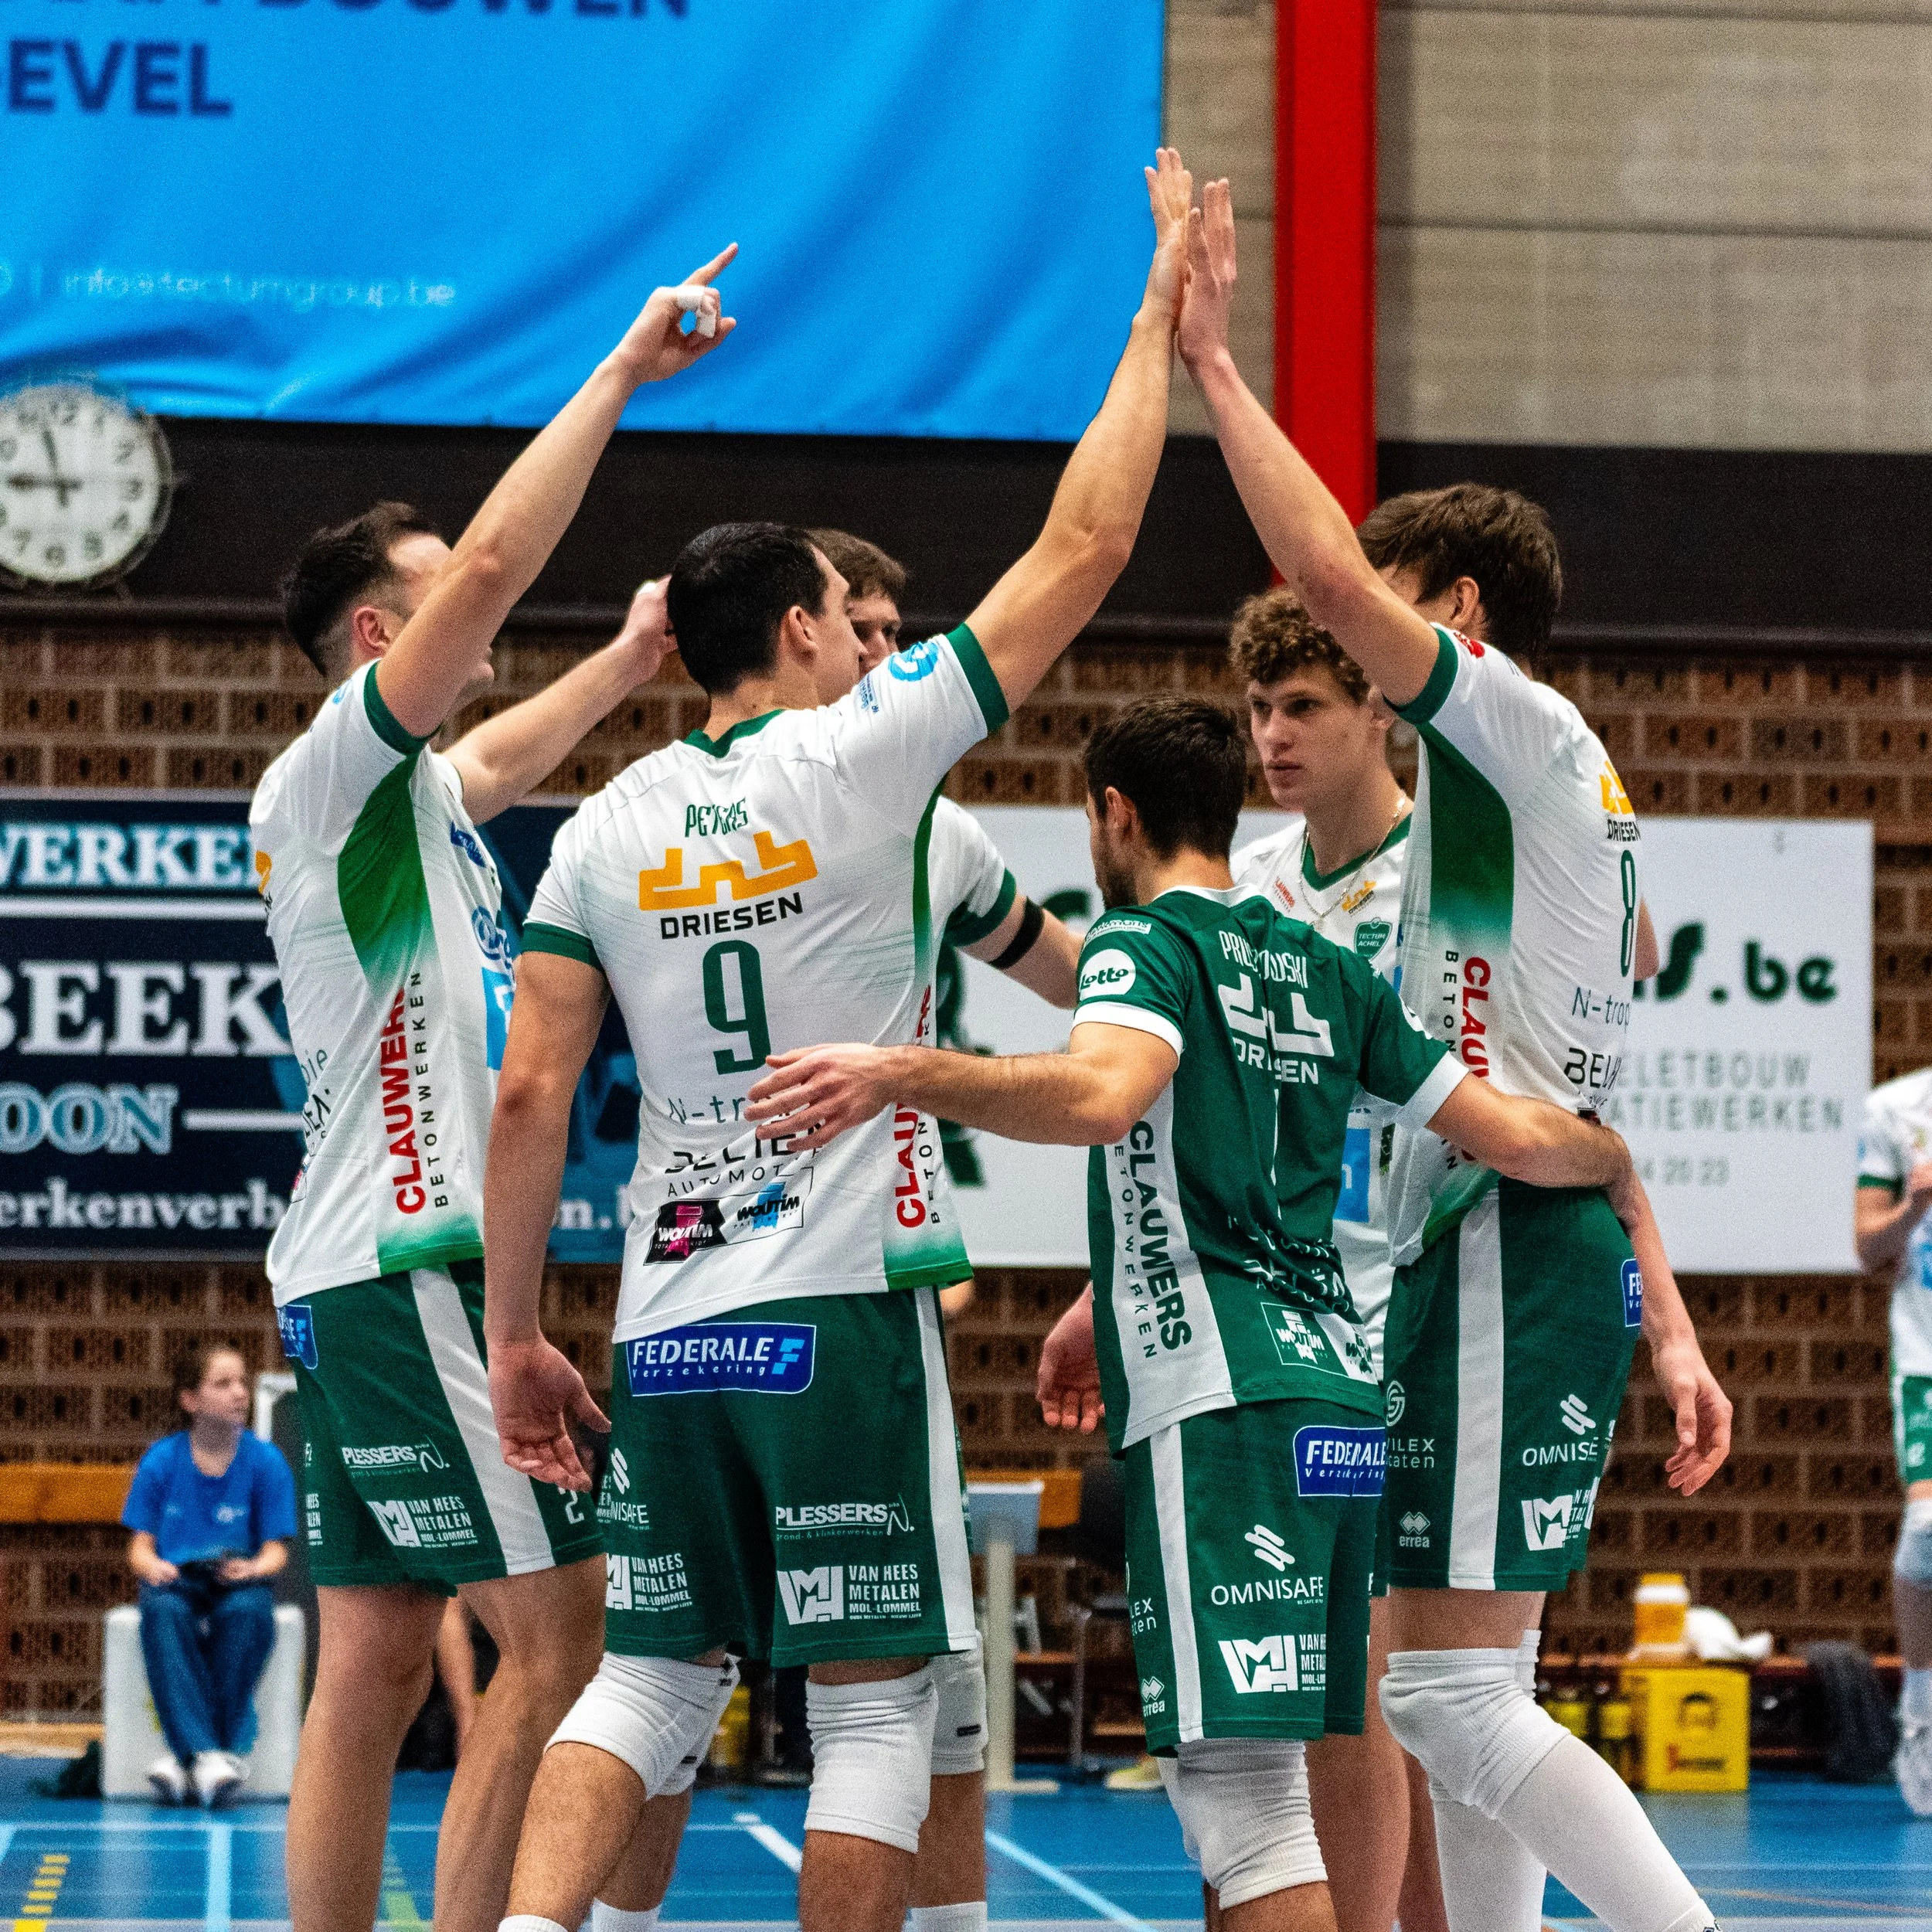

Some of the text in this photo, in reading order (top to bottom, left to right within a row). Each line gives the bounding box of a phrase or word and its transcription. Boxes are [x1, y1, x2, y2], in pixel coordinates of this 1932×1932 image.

[0, 37, 234, 117] EVEL
[1607, 819, 1641, 842] DRIESEN
[0, 825, 261, 886] ERKE
[660, 892, 804, 940] DRIESEN
[1621, 849, 1637, 977] 8
[1359, 932, 1386, 940] TECTUM
[0, 961, 294, 1055] EEK
[702, 939, 772, 1075] 9
[1442, 950, 1459, 1053] BETON
[1572, 986, 1631, 1034] N-trop
[1461, 956, 1491, 1079] CLAU
[412, 971, 449, 1208] BETONWERKEN
[668, 1093, 747, 1125] N-tr
[894, 1103, 927, 1227] CLAU
[919, 1122, 941, 1225] BETON
[1130, 1121, 1192, 1351] CLAUWERS
[1114, 1145, 1158, 1359] ETONWERKEN
[633, 1337, 774, 1366] FEDERALE
[342, 1445, 417, 1464] PLESSERS
[1386, 1437, 1435, 1452] ILEX
[406, 1496, 464, 1514] VAN HEES
[610, 1502, 650, 1525] NISAFE
[775, 1503, 888, 1526] PLESSERS
[414, 1512, 472, 1531] METALEN
[421, 1529, 477, 1543] MOL-LOMMEL
[1399, 1534, 1430, 1549] errea
[631, 1553, 684, 1574] VAN HEES
[849, 1564, 918, 1582] VAN HEES
[633, 1571, 688, 1594] METALEN
[849, 1583, 920, 1601] METALEN
[1211, 1577, 1324, 1605] OMNISAFE
[635, 1590, 692, 1607] MOL-LOMMEL
[849, 1601, 921, 1614] MOL-LOMMEL
[1129, 1597, 1154, 1618] LEX
[1299, 1634, 1319, 1651] VAN
